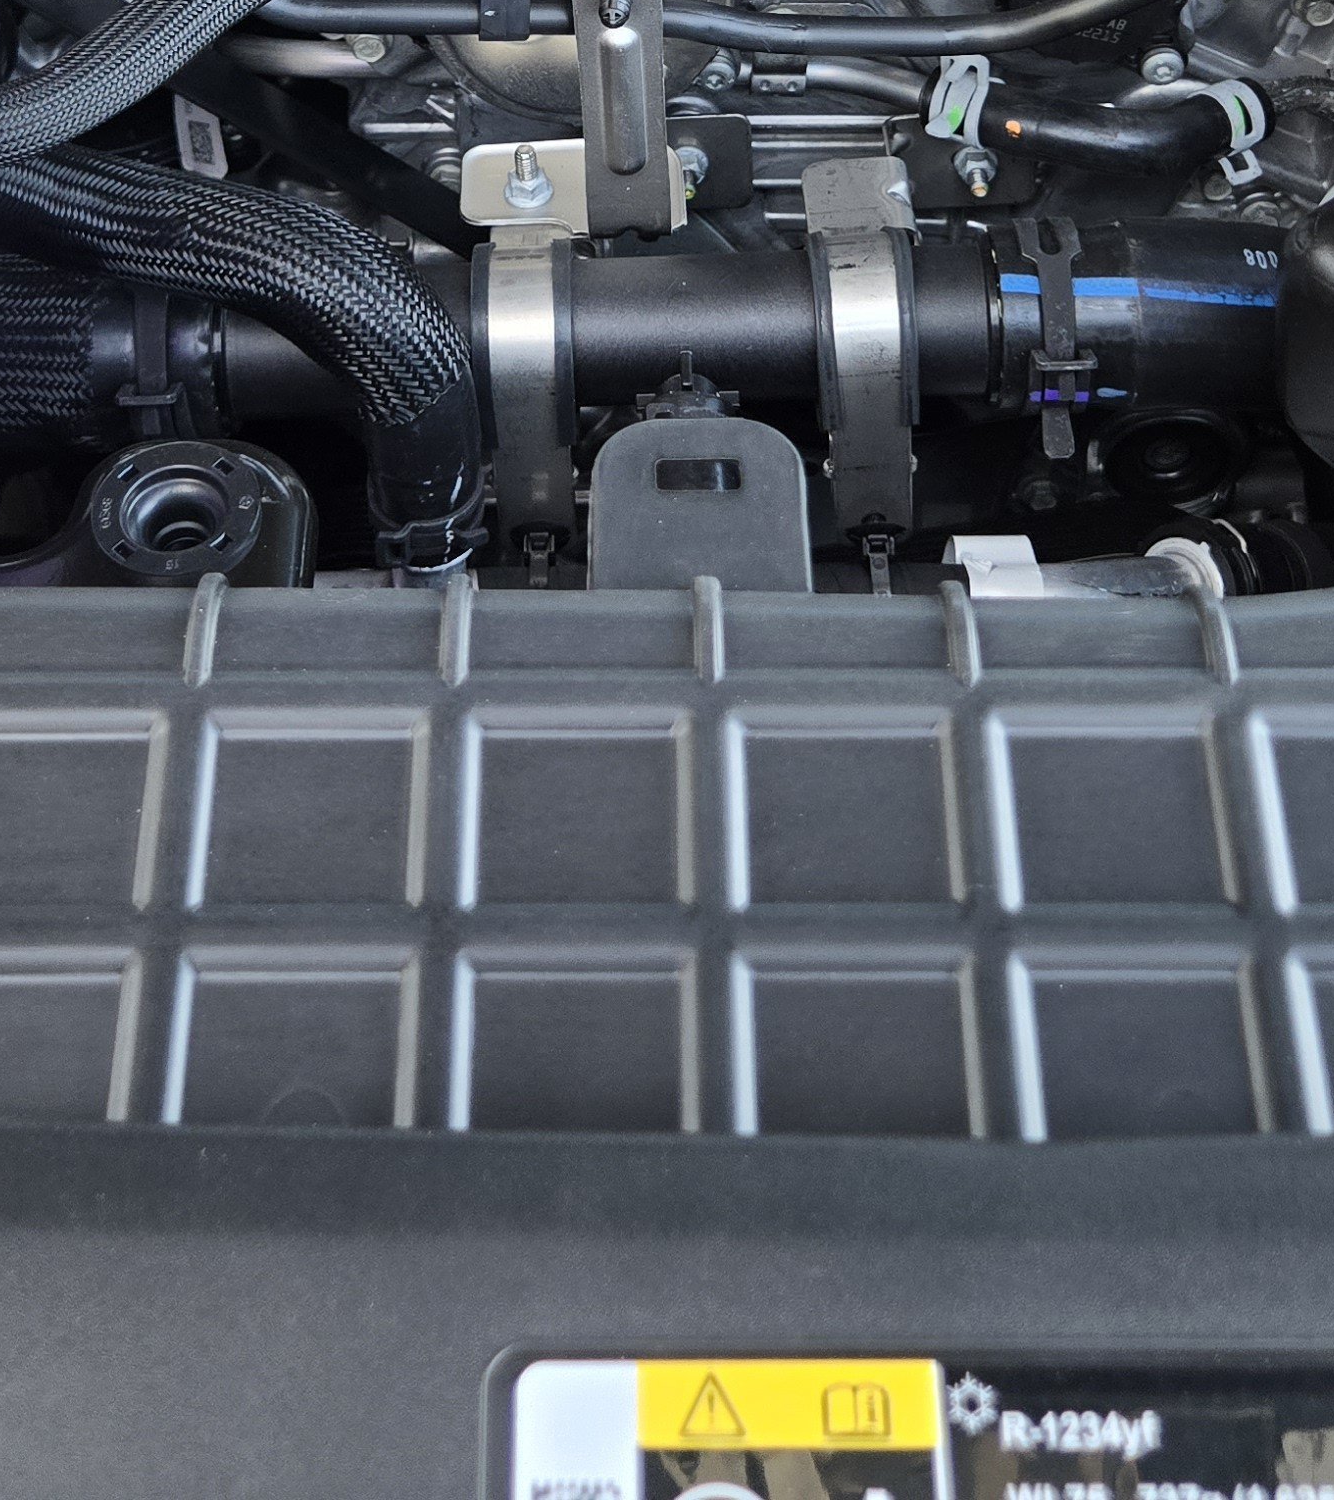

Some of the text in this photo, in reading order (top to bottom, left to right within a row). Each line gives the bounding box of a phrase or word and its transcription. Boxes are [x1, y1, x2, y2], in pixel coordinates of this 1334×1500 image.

[1106, 18, 1128, 31] AB
[1075, 26, 1123, 44] 2215
[999, 1408, 1164, 1462] R-1234yf
